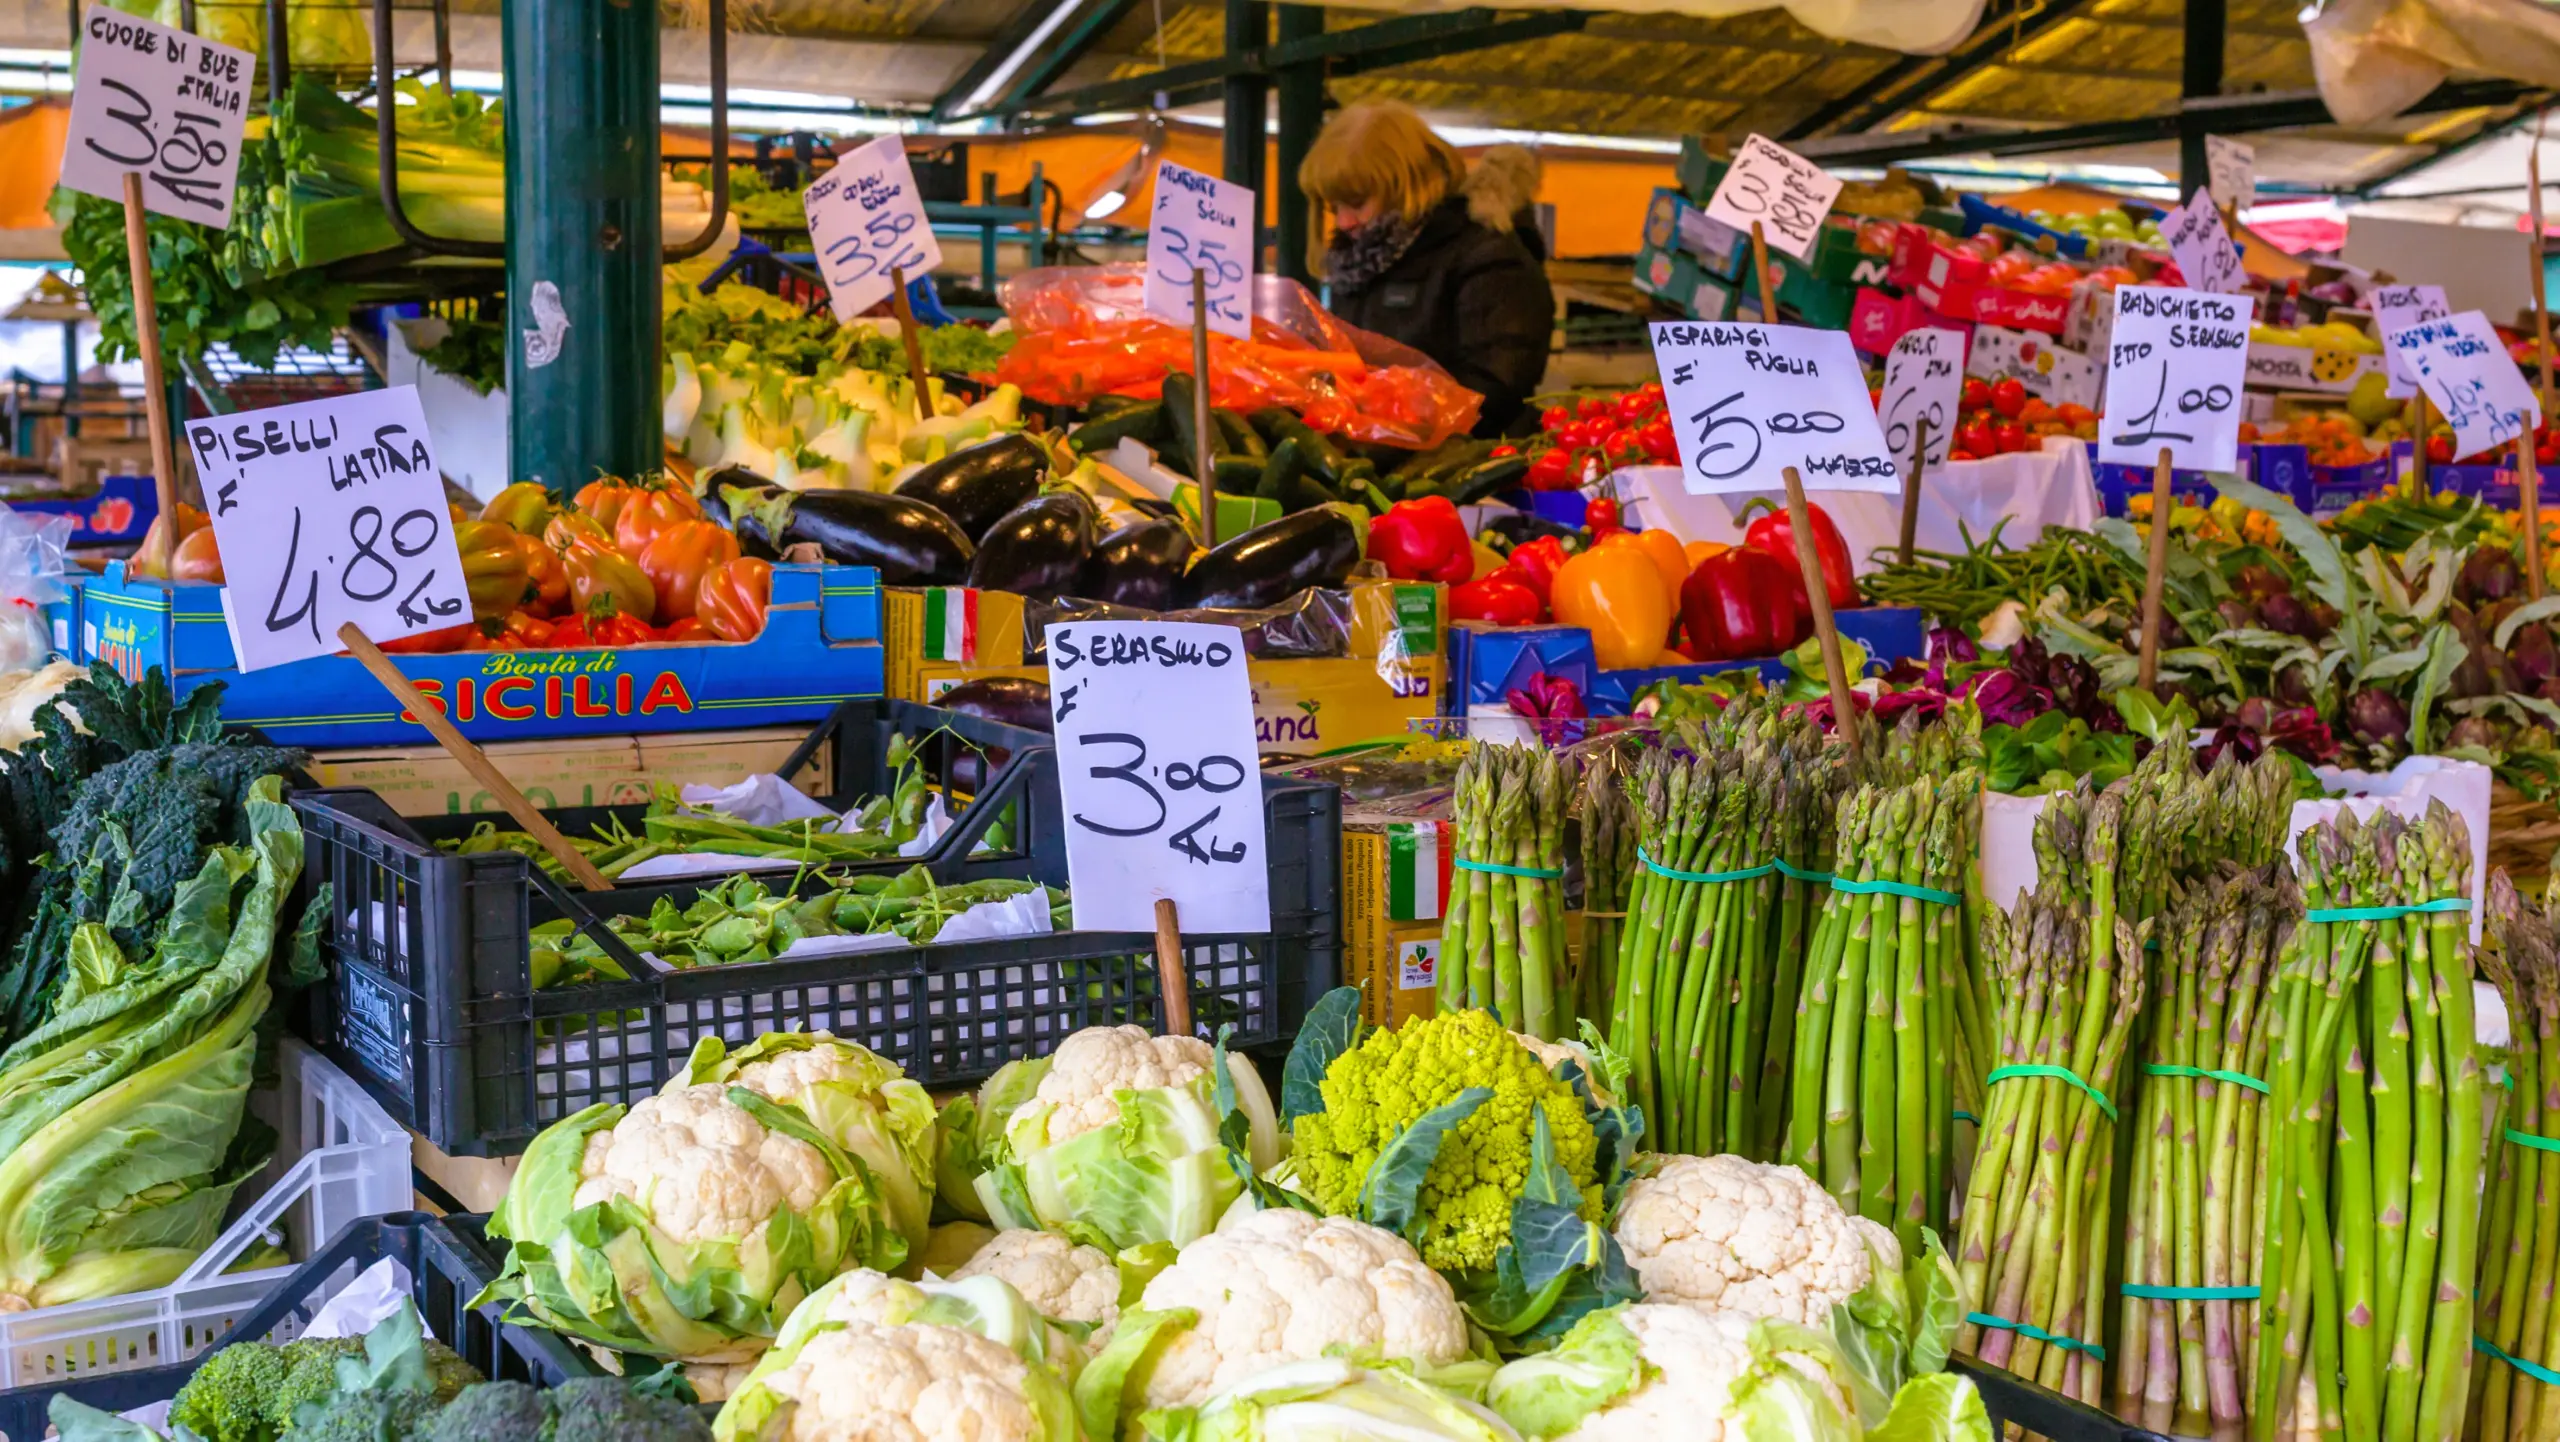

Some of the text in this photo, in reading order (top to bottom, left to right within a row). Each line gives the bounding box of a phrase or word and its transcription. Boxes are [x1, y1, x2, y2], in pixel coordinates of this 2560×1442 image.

[90, 17, 239, 83] CUORE DI BUE
[177, 75, 241, 115] ITALIA
[2120, 291, 2235, 321] RADICHIETTO
[1657, 325, 1770, 347] ASPARAGI
[1745, 350, 1819, 378] PUGLIA
[2114, 343, 2152, 368] ETTO
[191, 414, 338, 471] PISELLI
[482, 651, 617, 677] Bontà di
[400, 671, 694, 724] SICILIA
